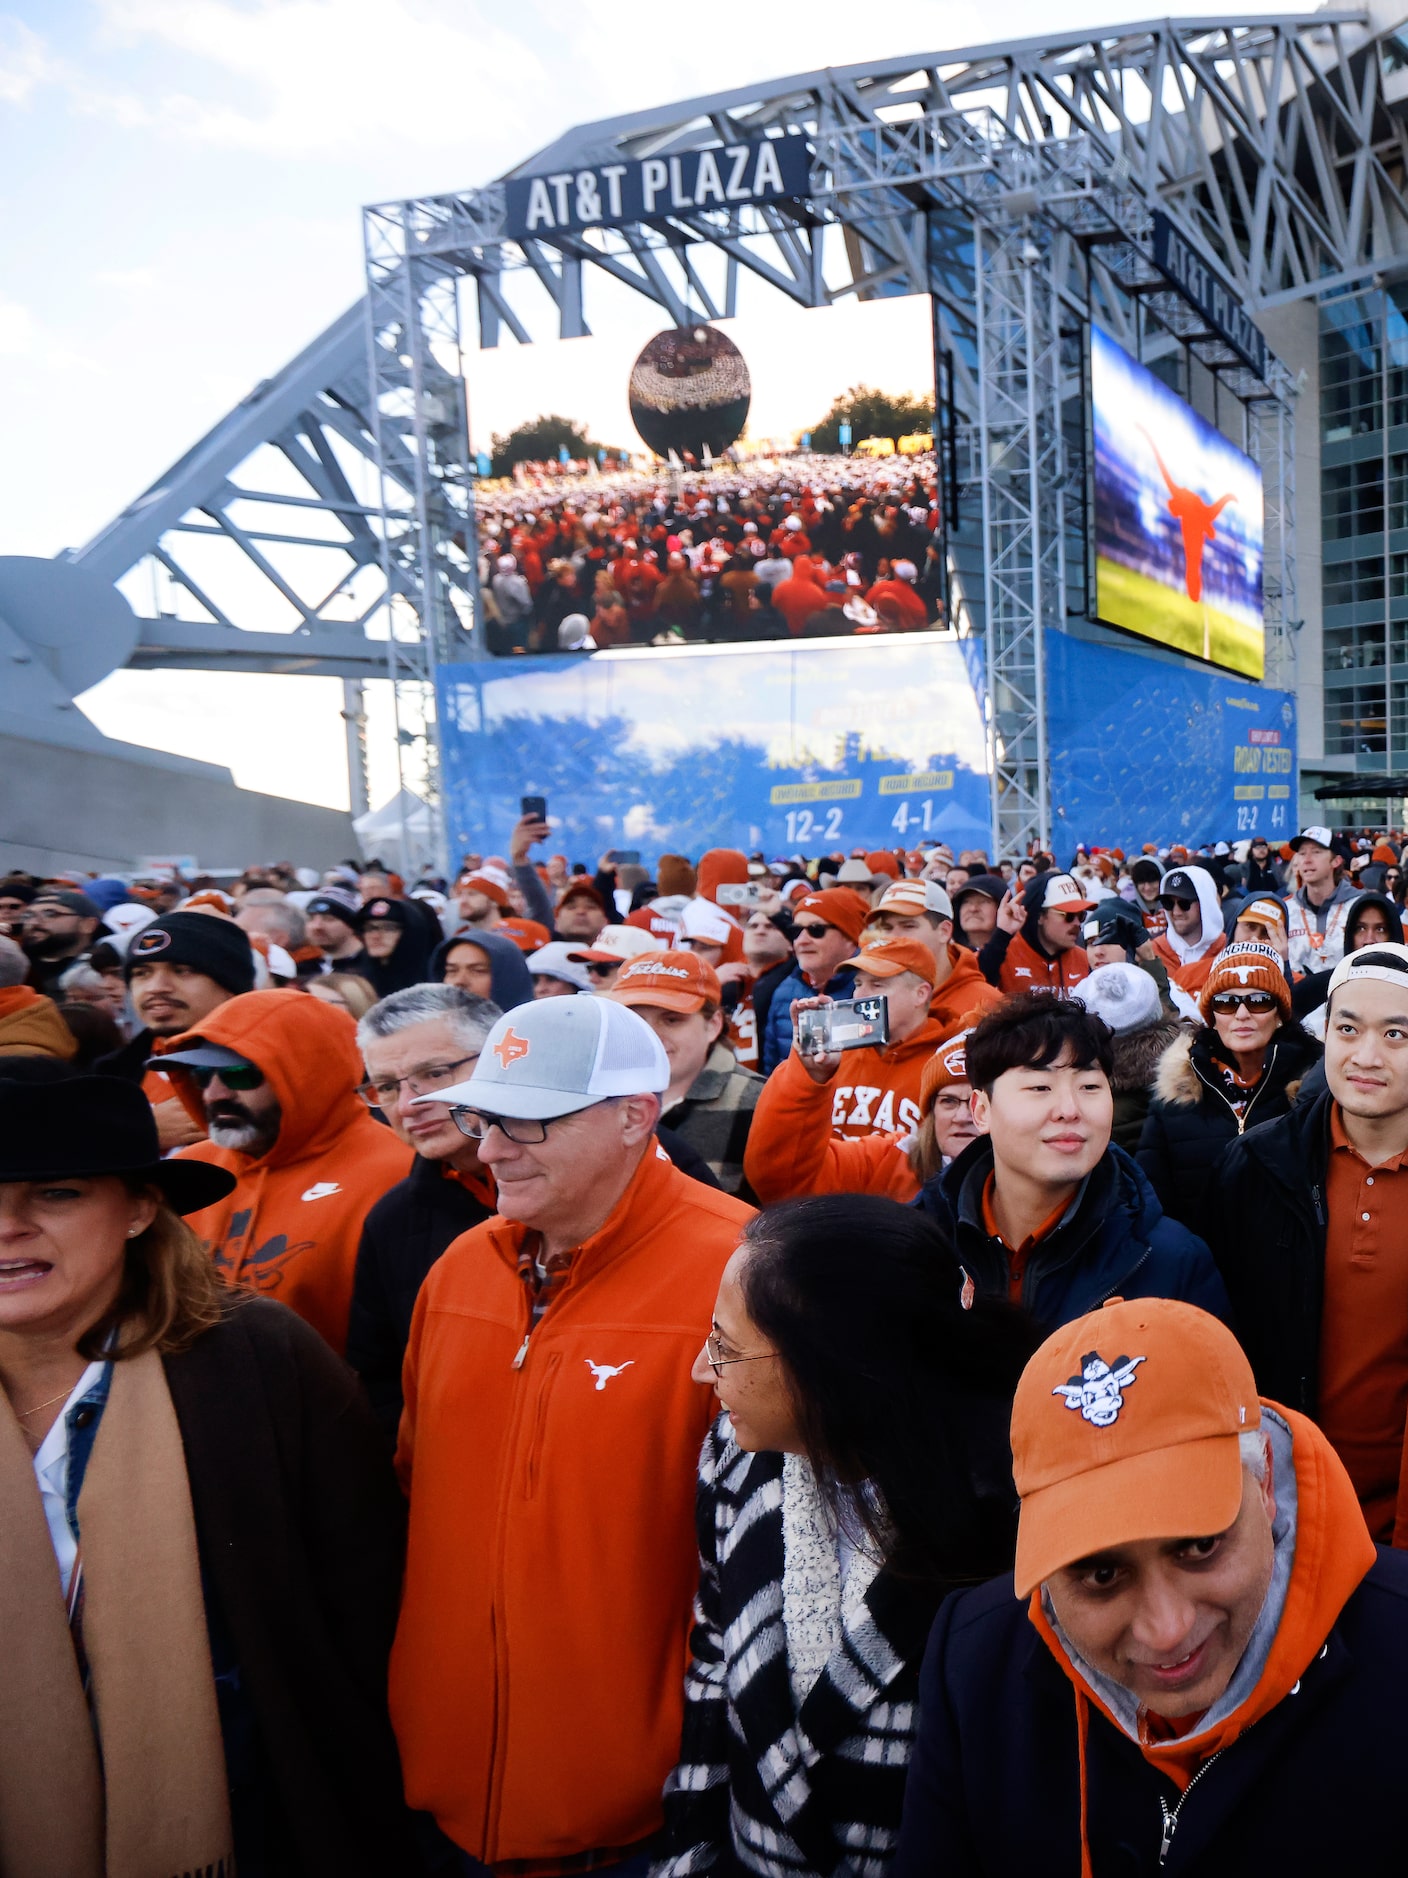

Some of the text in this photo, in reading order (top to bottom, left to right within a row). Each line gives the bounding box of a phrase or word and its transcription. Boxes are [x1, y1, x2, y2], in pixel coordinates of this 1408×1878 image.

[526, 141, 785, 231] AT&T PLAZA
[1166, 229, 1261, 368] AT&T PLAZA
[1234, 745, 1292, 774] ROAD TESTED
[785, 807, 843, 843] 12-2
[891, 799, 933, 834] 4-1
[1237, 806, 1259, 831] 12-2
[1271, 805, 1285, 828] 4-1
[622, 960, 689, 979] Titleist
